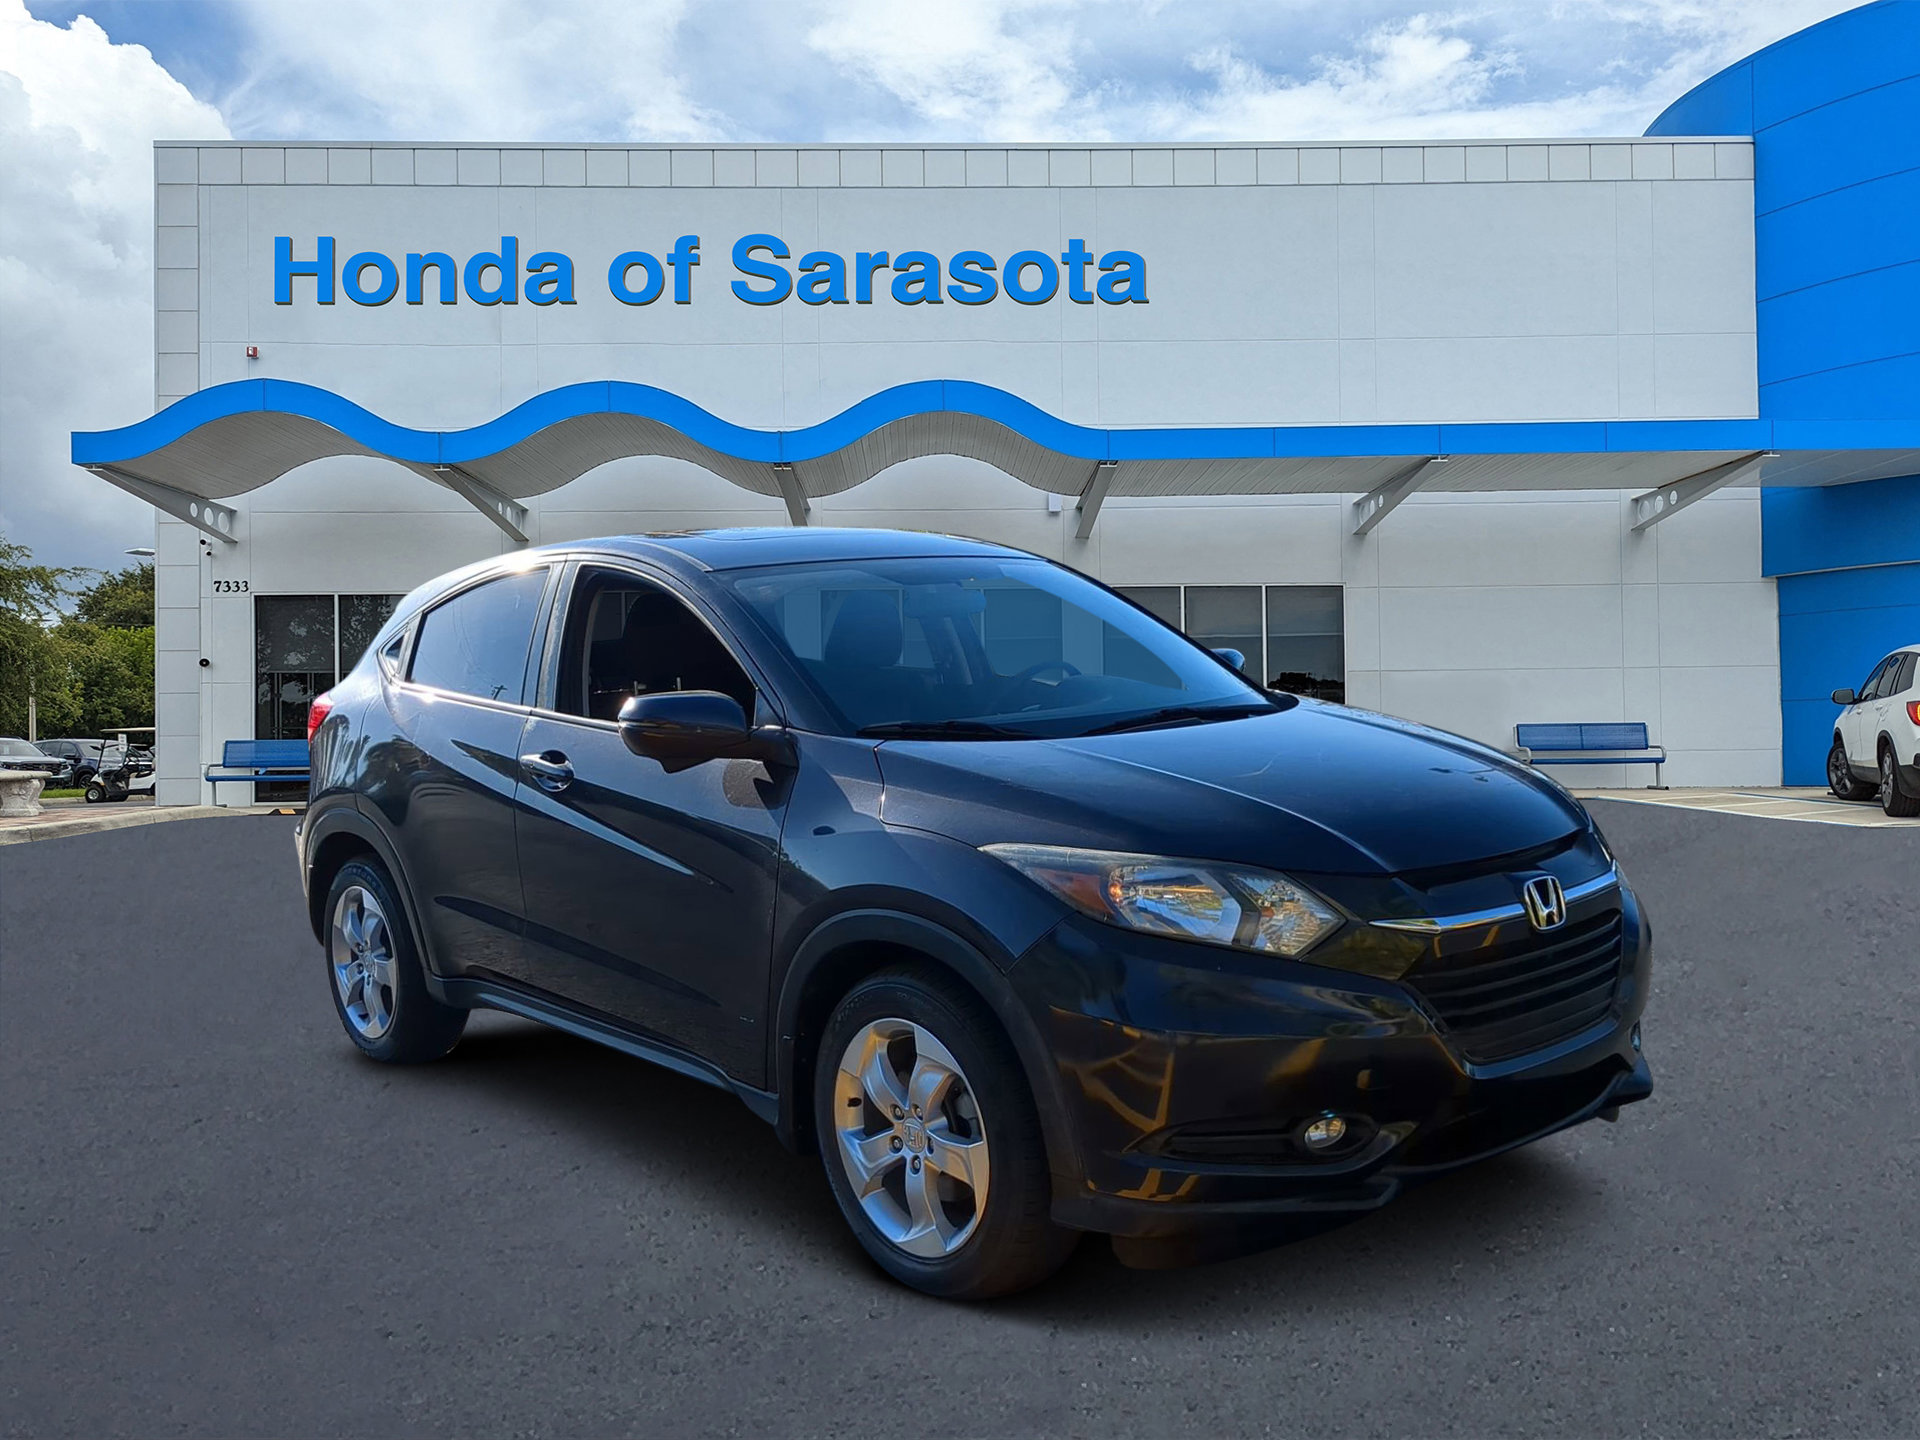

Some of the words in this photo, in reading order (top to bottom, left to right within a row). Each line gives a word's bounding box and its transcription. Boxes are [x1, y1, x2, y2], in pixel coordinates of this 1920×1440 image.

[273, 235, 576, 305] Honda
[607, 234, 700, 305] of
[730, 233, 1149, 305] Sarasota
[213, 580, 249, 593] 7333
